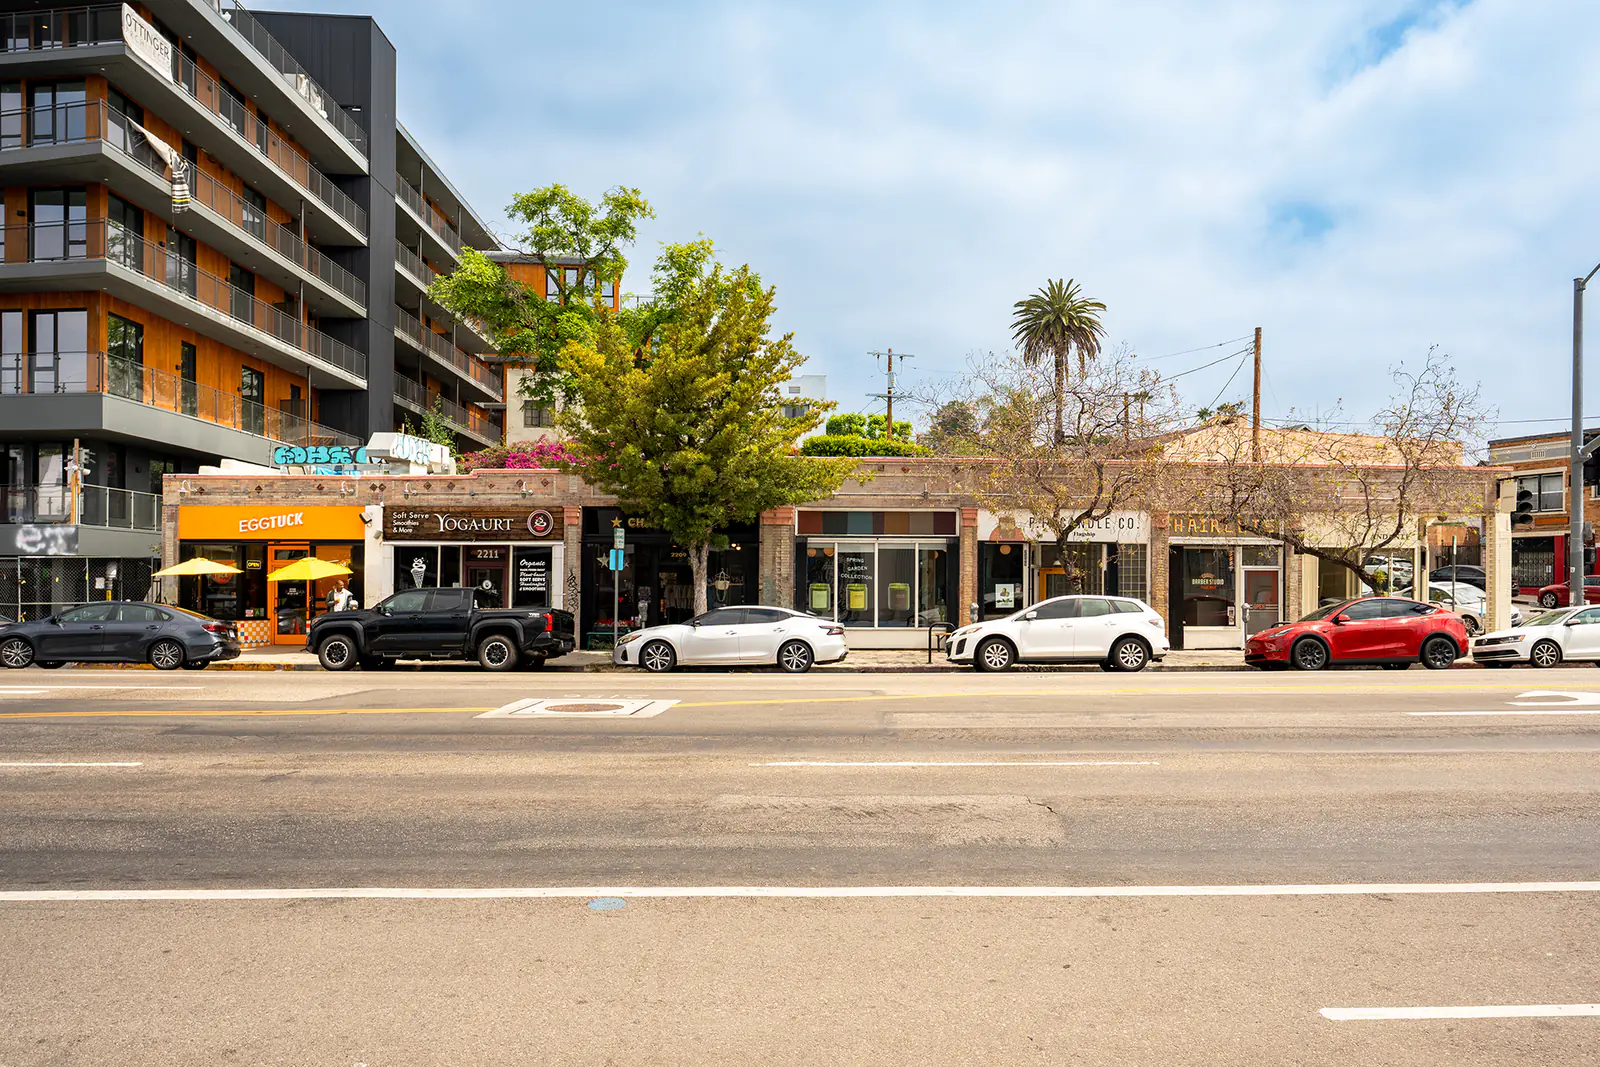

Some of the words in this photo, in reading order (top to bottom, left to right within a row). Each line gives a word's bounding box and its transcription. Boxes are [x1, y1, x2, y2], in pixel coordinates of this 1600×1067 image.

[126, 13, 170, 60] OTTINGER
[392, 511, 407, 519] Soft
[409, 511, 430, 519] Serve
[239, 512, 304, 533] EGGTUCK
[1118, 517, 1140, 529] CO.
[477, 549, 499, 559] 2211
[519, 558, 546, 568] Organic
